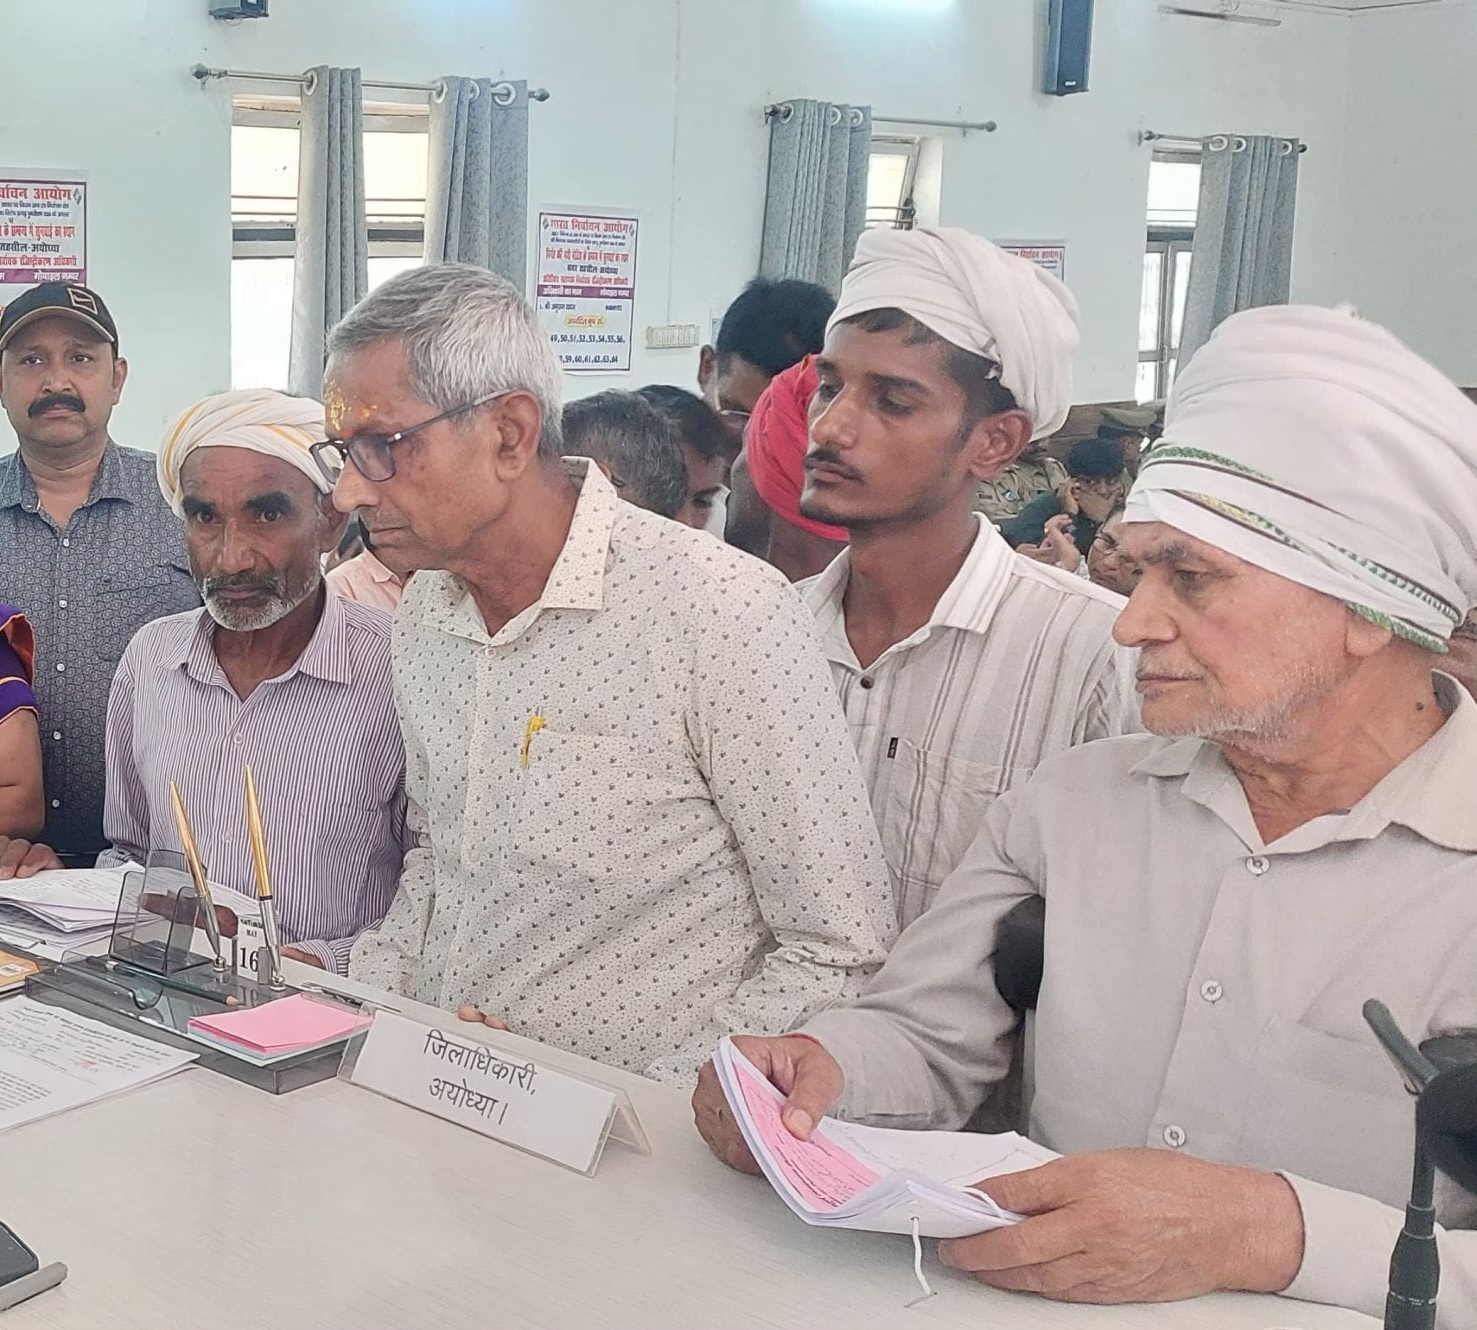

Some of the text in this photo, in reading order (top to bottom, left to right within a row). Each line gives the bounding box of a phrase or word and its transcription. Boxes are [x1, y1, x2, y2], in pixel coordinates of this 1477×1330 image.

[34, 186, 72, 200] आयोग
[239, 947, 259, 972] 16
[424, 1029, 538, 1096] जिलाधिकारी,
